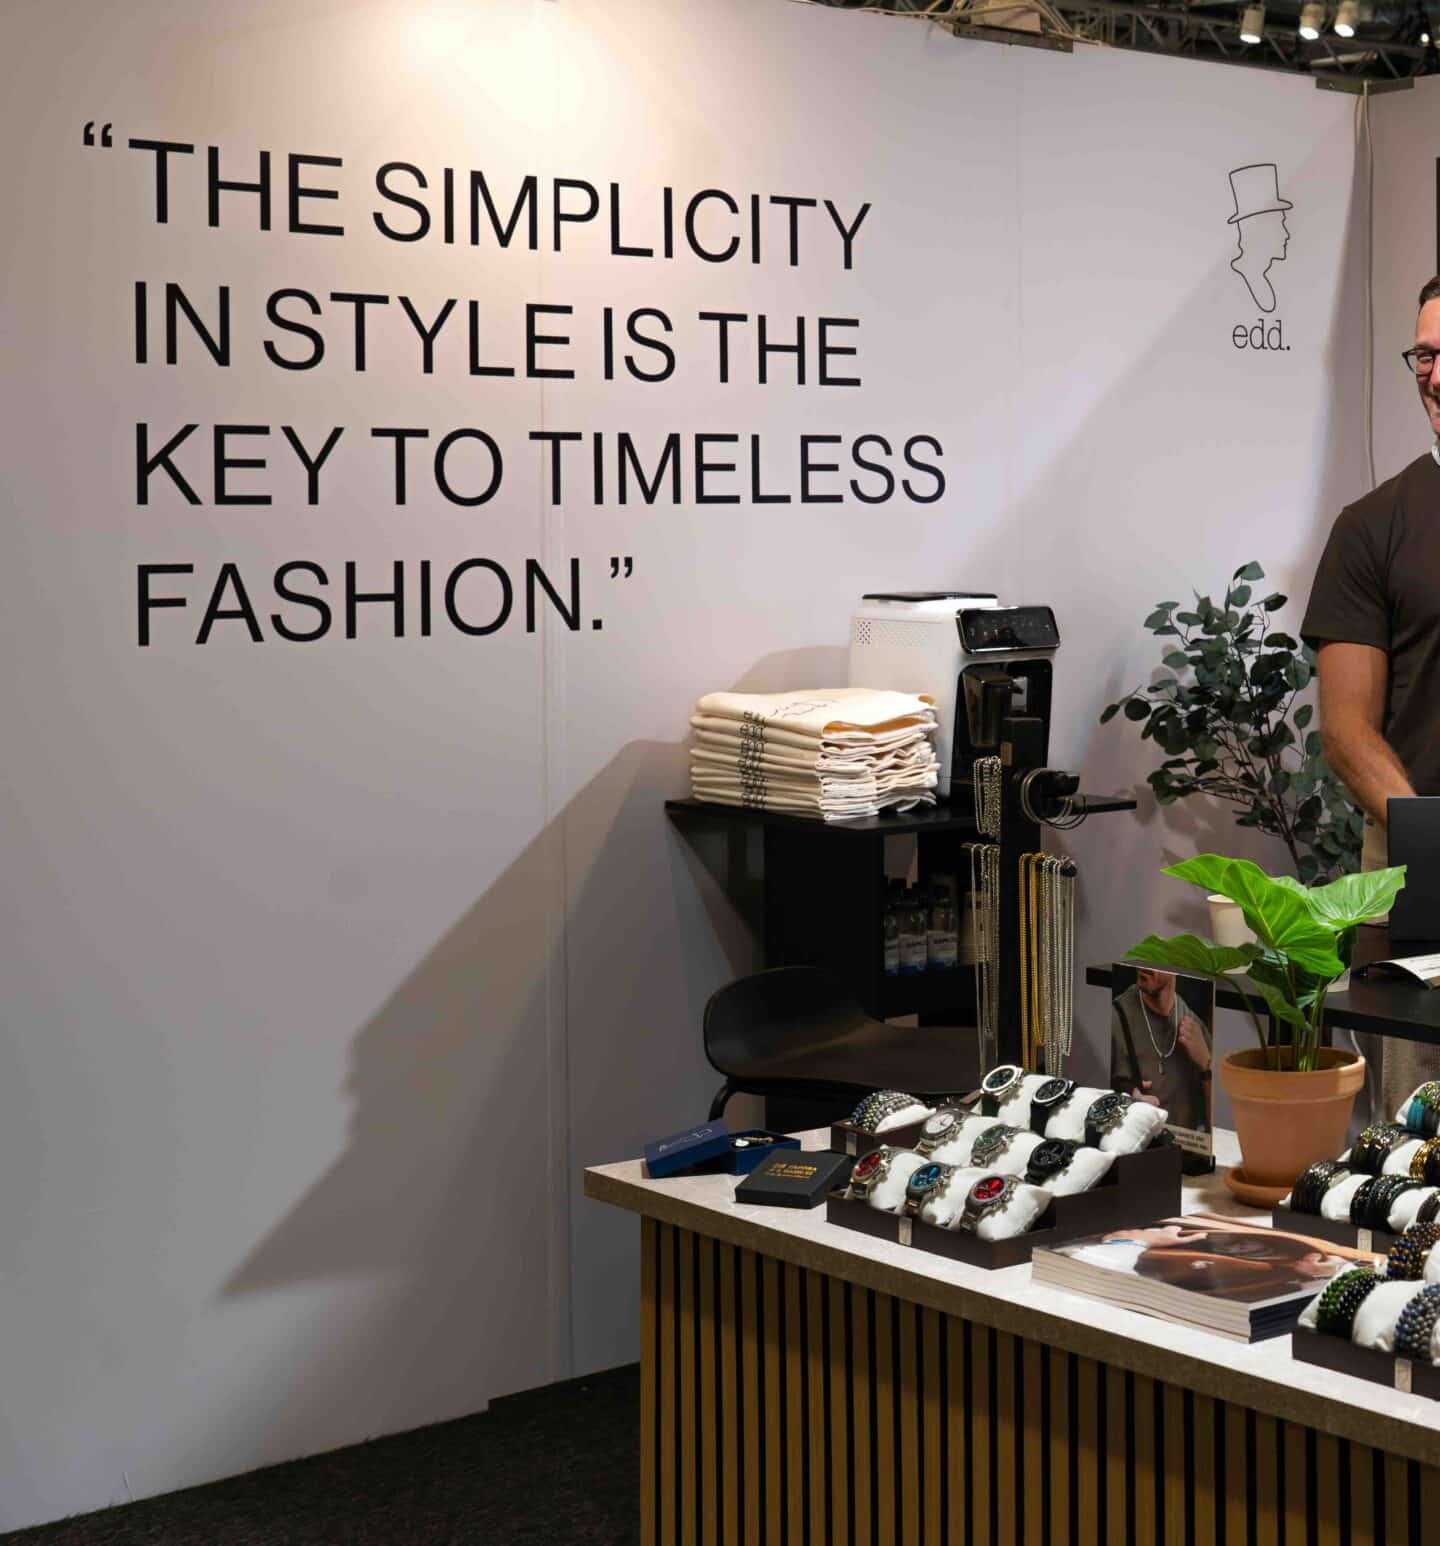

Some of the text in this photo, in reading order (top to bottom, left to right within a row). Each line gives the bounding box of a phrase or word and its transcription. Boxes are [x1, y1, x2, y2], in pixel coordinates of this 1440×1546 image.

[373, 162, 871, 270] SIMPLICITY
[135, 281, 861, 387] IN STYLE IS THE
[1232, 318, 1291, 351] edd.
[136, 422, 946, 507] KEY TO TIMELESS
[137, 556, 633, 647] FASHION.”
